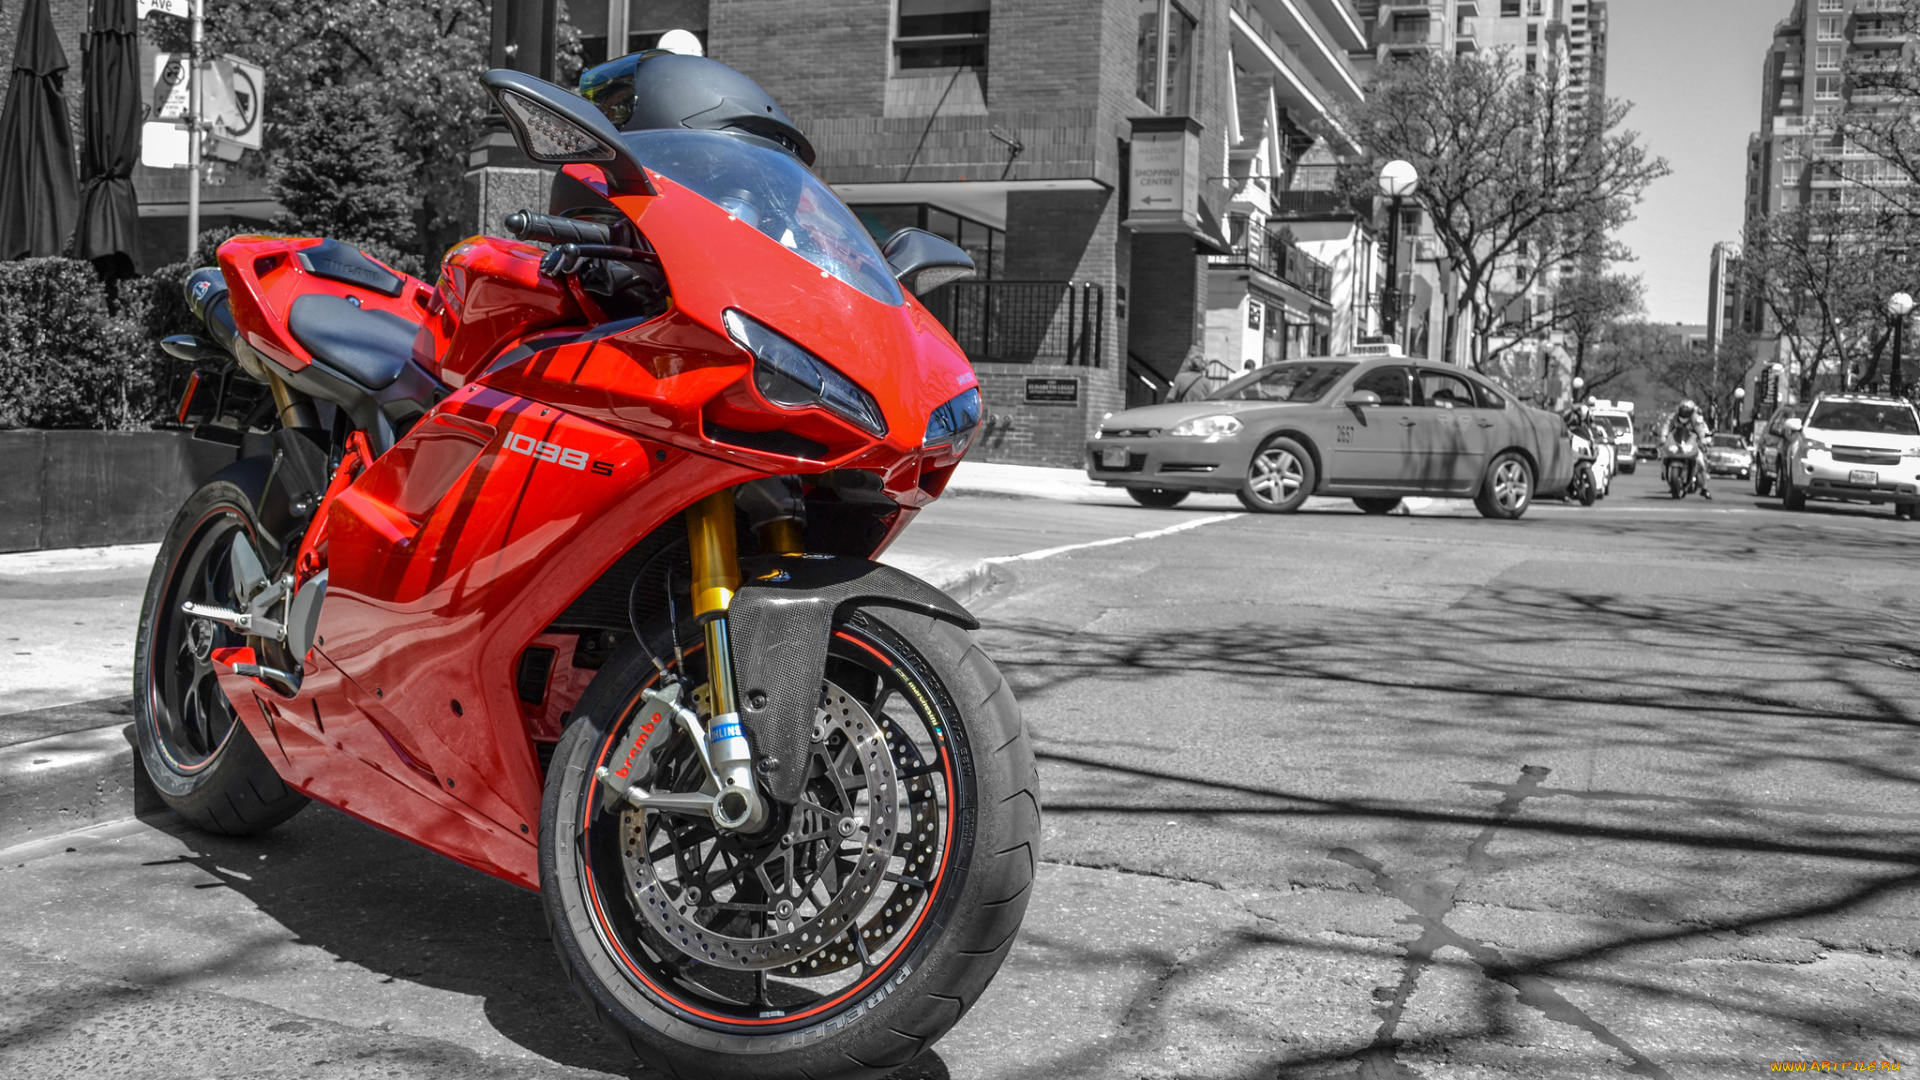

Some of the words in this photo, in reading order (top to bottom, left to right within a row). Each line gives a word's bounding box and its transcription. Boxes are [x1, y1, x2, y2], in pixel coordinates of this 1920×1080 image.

[1134, 168, 1180, 178] SHOPPING
[1140, 177, 1174, 186] CENTRE
[502, 431, 590, 471] 1098
[590, 460, 615, 477] S
[1336, 425, 1355, 444] 2657
[908, 682, 938, 726] marchesini
[615, 712, 661, 778] brembo
[790, 964, 913, 1045] PIRELLI
